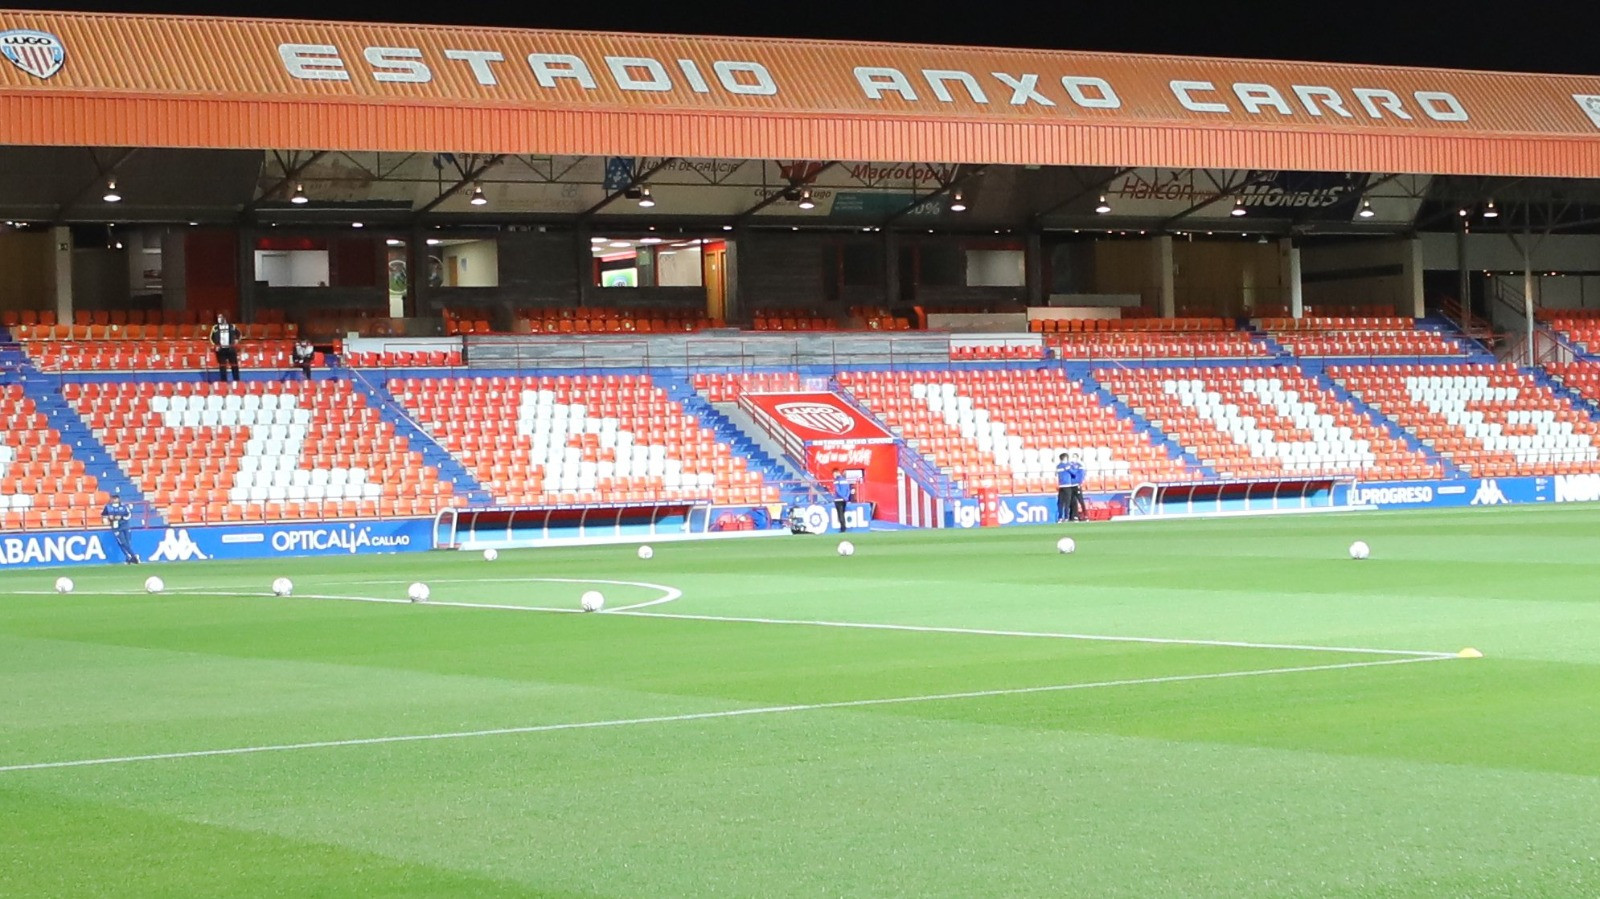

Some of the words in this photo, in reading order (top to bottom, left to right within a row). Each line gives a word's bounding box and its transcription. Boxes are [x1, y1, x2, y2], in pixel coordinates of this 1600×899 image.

[4, 36, 52, 45] LUGO
[278, 43, 778, 97] ESTADIO
[853, 66, 1122, 109] ANXO
[1169, 79, 1469, 122] CARRO
[1015, 501, 1048, 523] Sm
[371, 535, 411, 545] CALLAO
